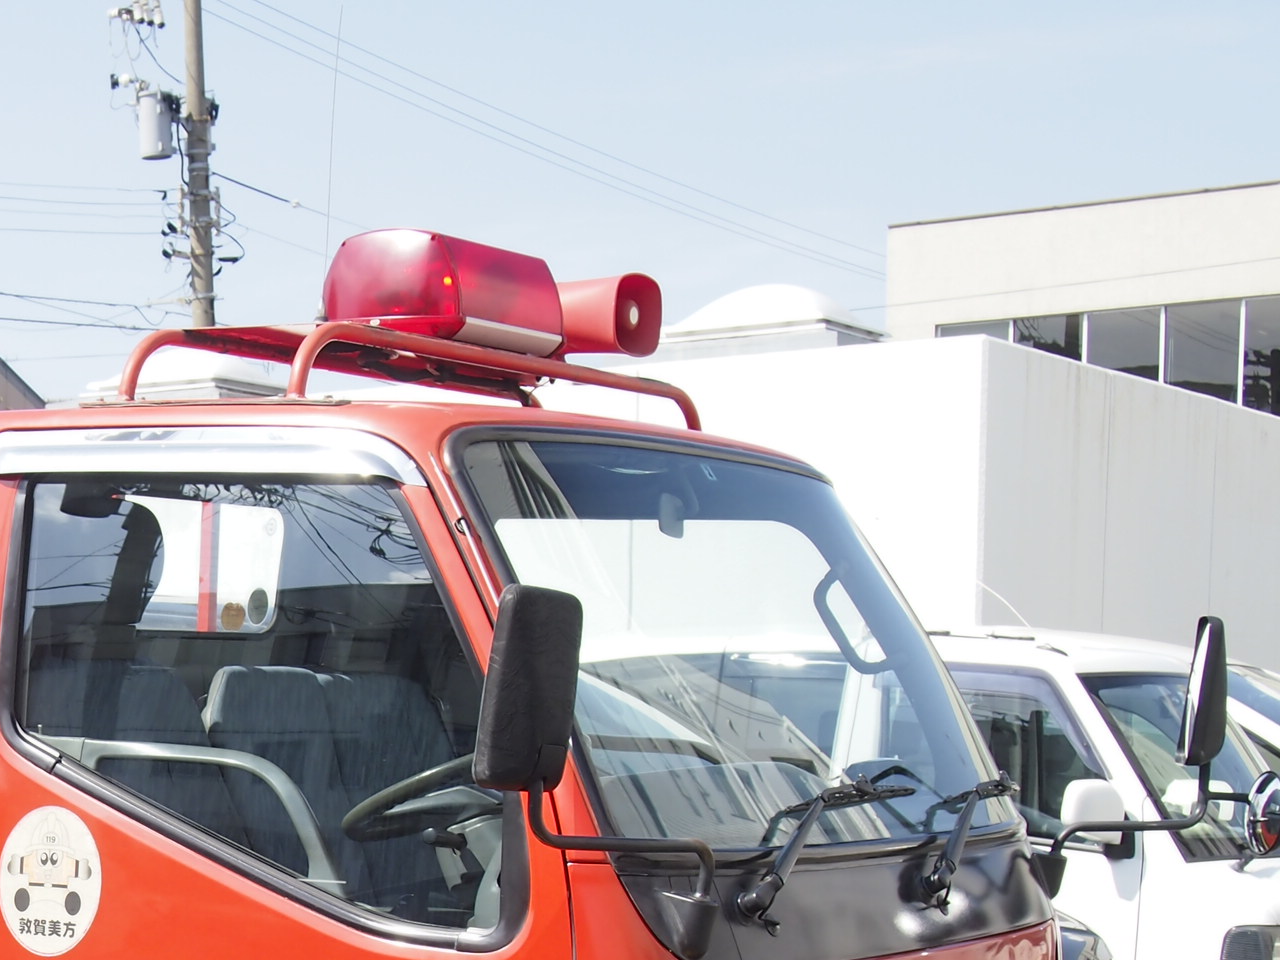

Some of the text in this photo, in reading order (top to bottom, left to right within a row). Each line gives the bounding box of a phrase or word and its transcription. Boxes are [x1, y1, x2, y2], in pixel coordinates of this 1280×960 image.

[46, 835, 57, 844] 119
[19, 917, 77, 938] 敦賀美方
